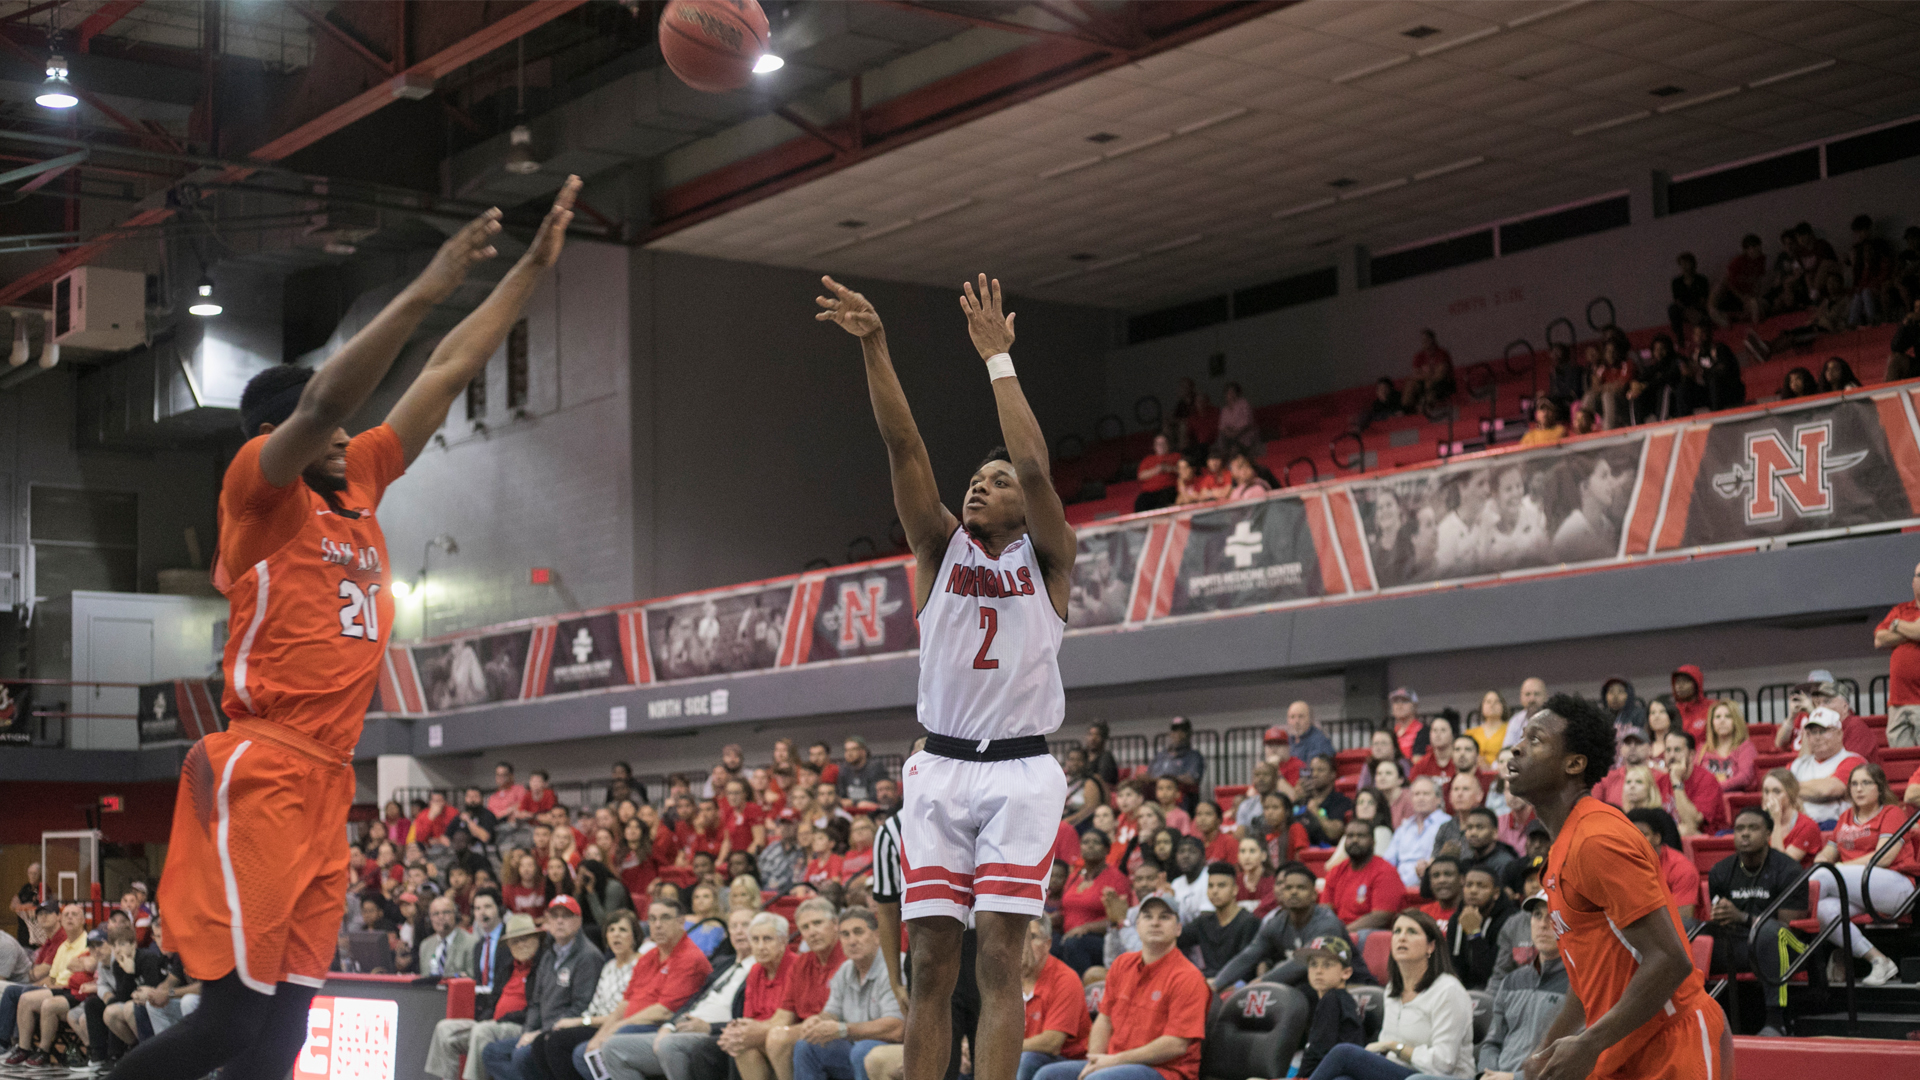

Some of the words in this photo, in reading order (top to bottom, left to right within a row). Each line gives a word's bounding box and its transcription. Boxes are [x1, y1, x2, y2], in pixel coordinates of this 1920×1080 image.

[1744, 418, 1833, 525] N
[339, 578, 381, 642] 20
[838, 577, 887, 649] N
[973, 606, 999, 669] 2
[648, 699, 682, 719] NORTH
[684, 695, 709, 716] SIDE
[1243, 990, 1271, 1017] N
